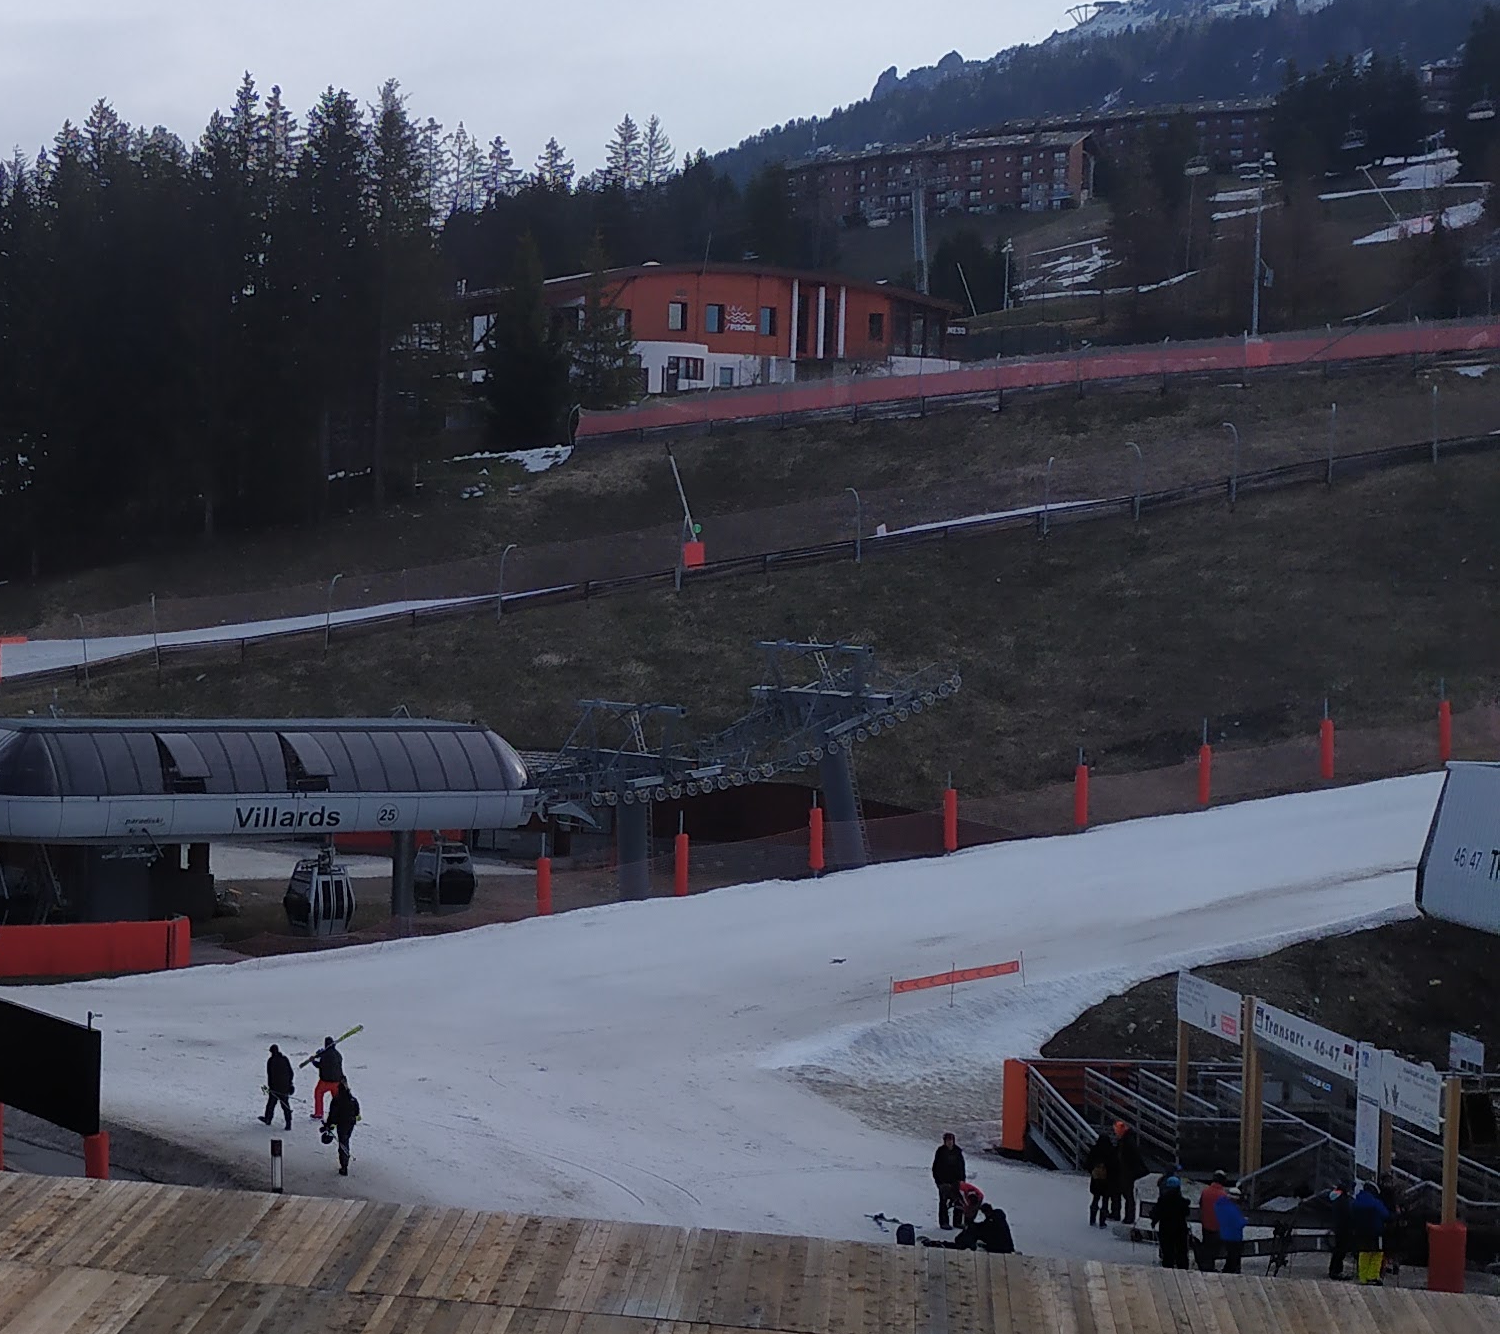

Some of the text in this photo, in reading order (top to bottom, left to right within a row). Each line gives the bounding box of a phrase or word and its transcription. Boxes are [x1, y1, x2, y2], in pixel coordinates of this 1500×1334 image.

[235, 805, 396, 828] Villards 25
[1469, 851, 1483, 870] 47
[1265, 1014, 1304, 1048] Transarc
[1314, 1039, 1340, 1062] 46-47
